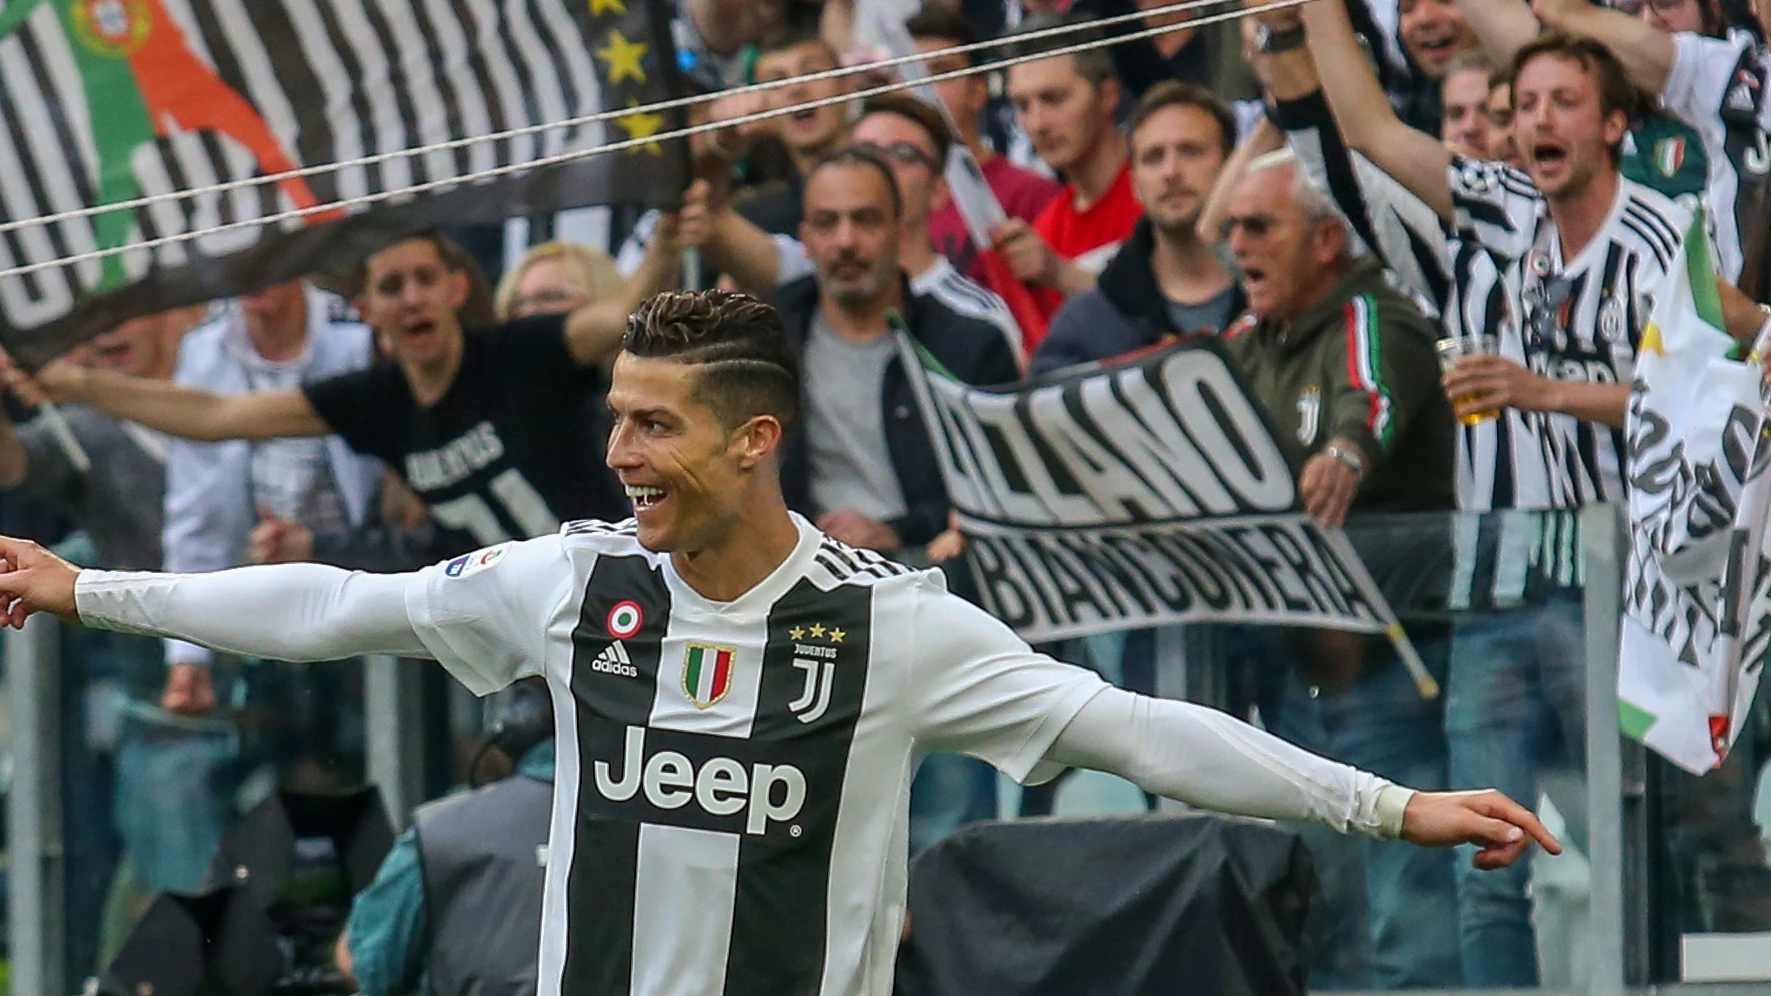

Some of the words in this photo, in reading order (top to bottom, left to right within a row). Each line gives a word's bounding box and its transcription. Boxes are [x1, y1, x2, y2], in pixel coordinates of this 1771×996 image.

[973, 520, 1385, 629] BIANCONERA
[591, 659, 638, 678] adidas
[794, 642, 838, 659] JUVENTUS
[593, 725, 808, 836] Jeep
